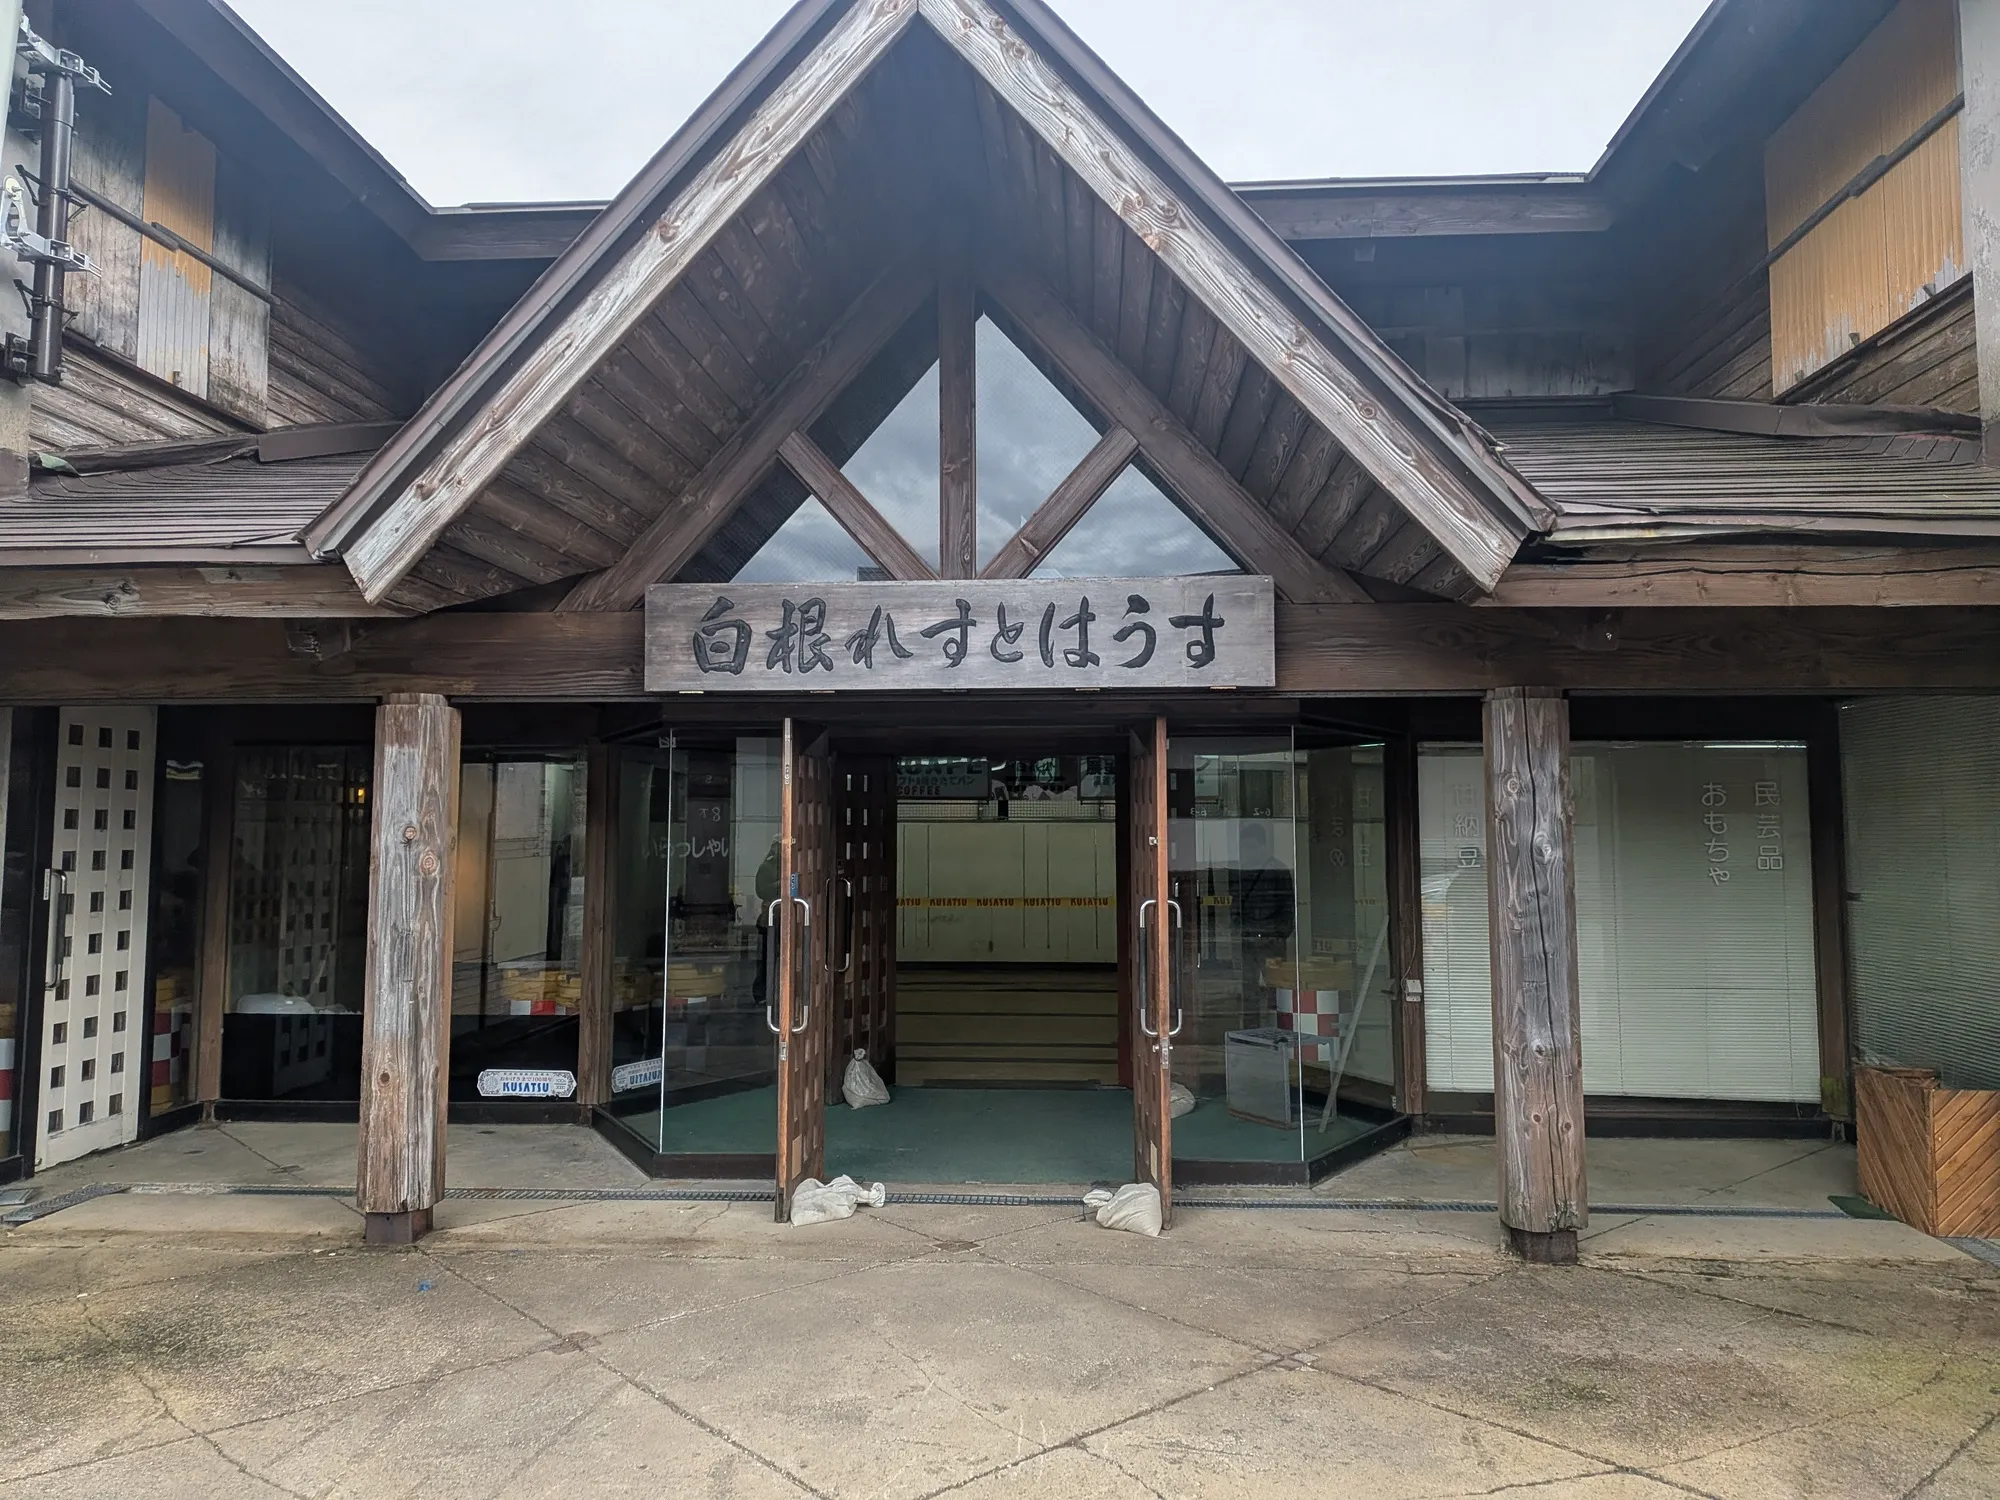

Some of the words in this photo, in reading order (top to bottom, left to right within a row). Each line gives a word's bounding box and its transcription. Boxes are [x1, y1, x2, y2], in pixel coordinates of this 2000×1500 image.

[693, 593, 1225, 674] 白根れすとはうす
[1453, 783, 1480, 868] 甘納豆
[1755, 782, 1782, 869] 民芸品
[502, 1082, 549, 1092] KUSATSU
